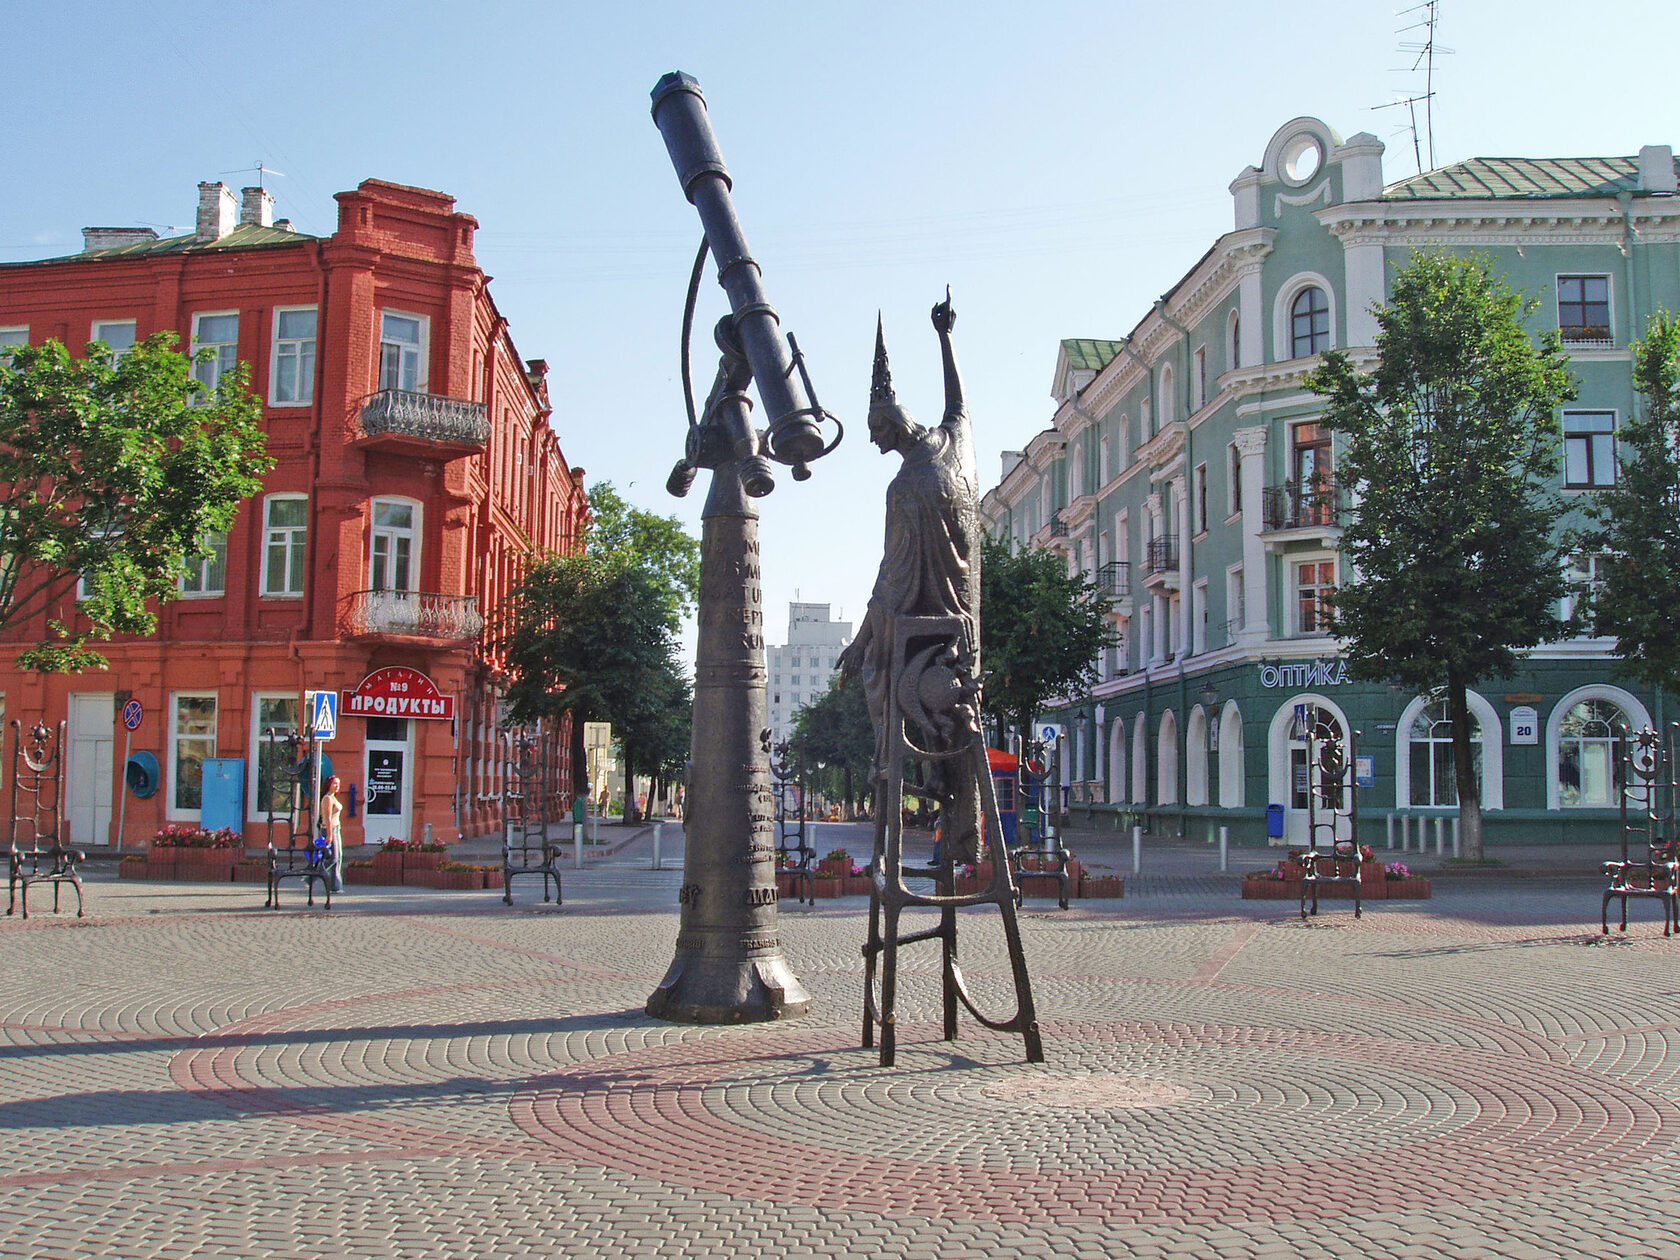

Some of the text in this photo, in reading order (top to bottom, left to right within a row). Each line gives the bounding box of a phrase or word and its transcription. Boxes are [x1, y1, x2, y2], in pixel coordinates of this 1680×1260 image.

[365, 671, 433, 695] МАГАЗИН
[1261, 660, 1353, 688] ОПТИКА
[390, 682, 408, 692] №9
[351, 695, 445, 714] ПРОДУКТЫ
[1517, 726, 1531, 736] 20
